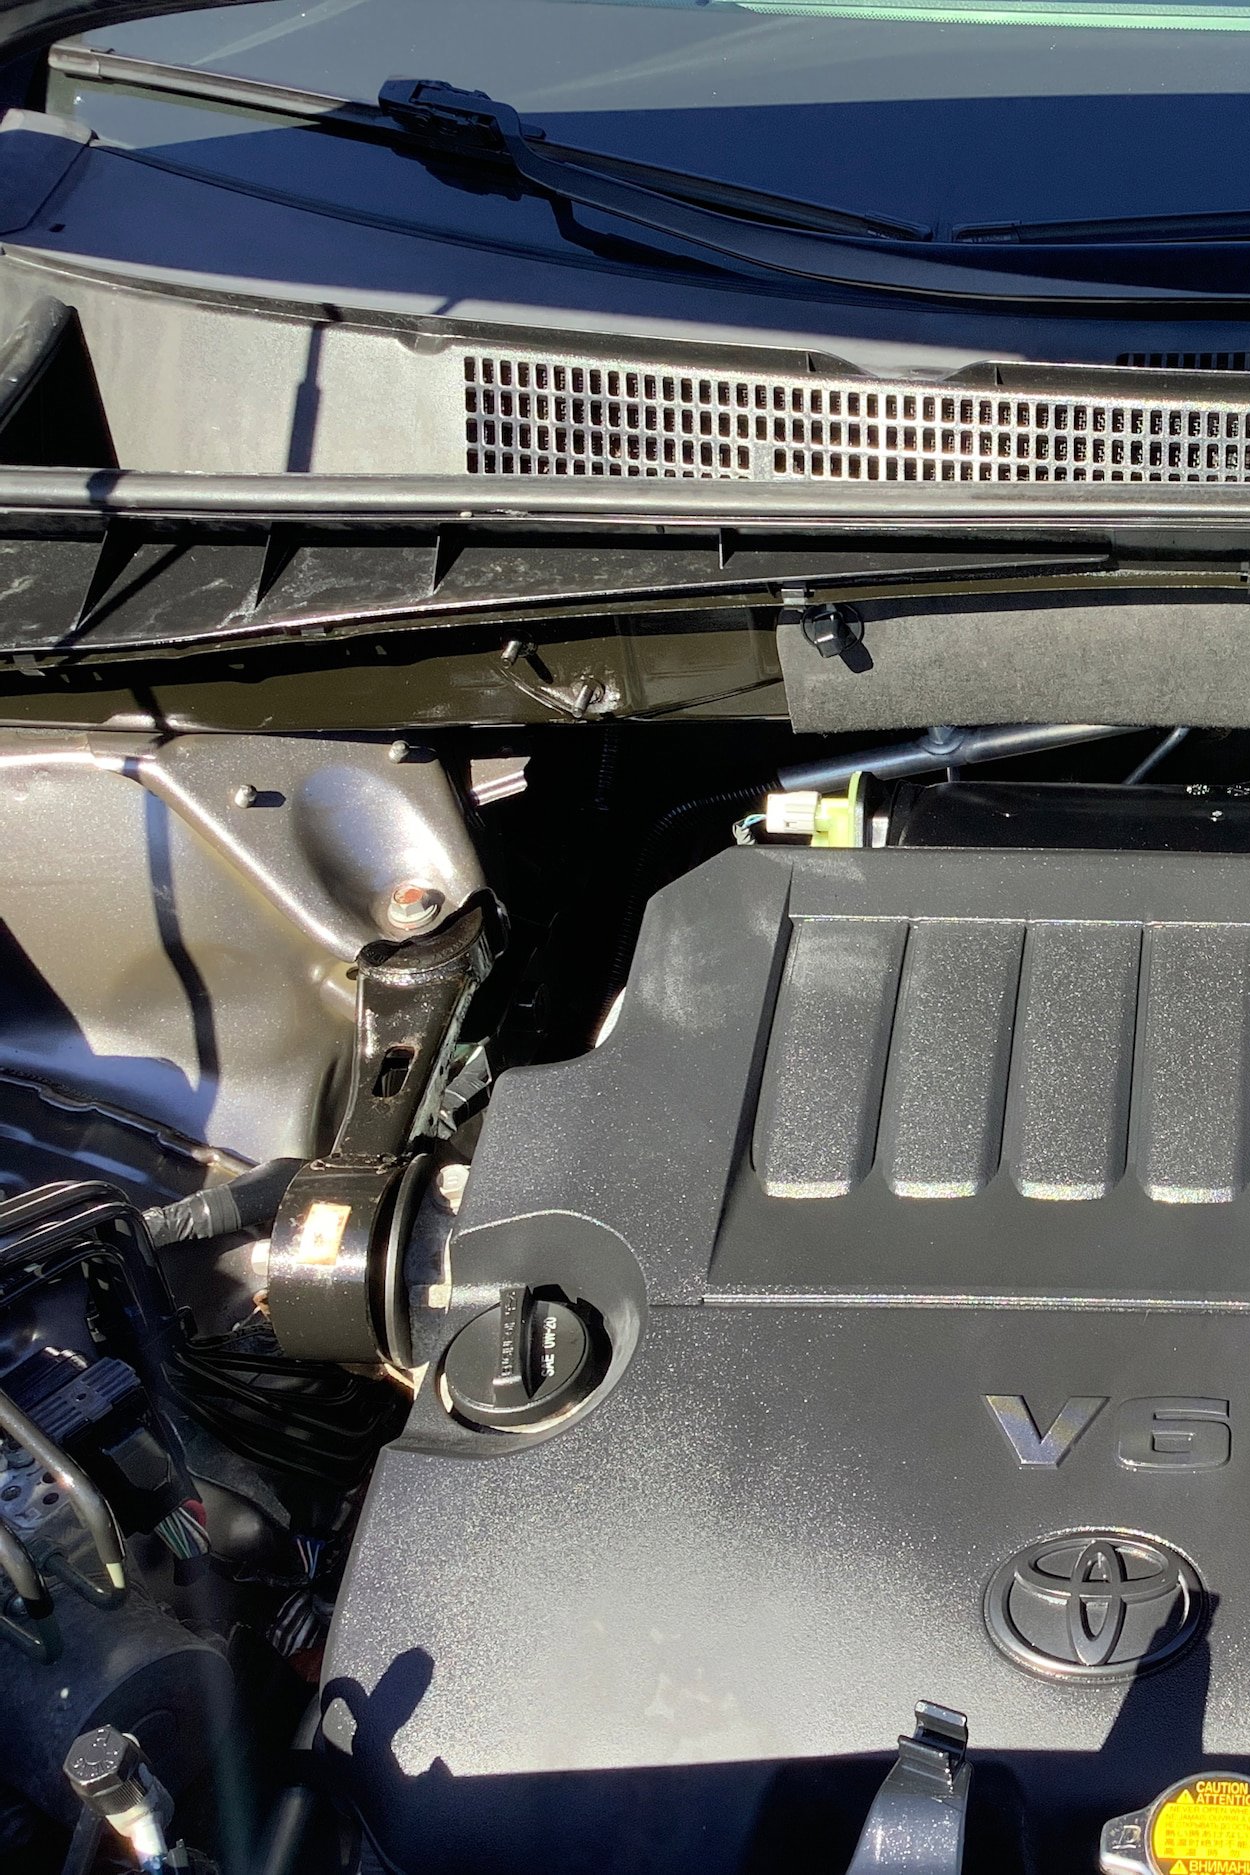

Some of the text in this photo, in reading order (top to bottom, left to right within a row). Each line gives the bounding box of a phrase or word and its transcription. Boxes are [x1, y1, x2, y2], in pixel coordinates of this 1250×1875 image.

[541, 1316, 558, 1378] SAE 0W-20
[977, 1393, 1233, 1473] V6
[1196, 1781, 1249, 1795] CAUTION
[1169, 1805, 1200, 1814] NEVER
[1202, 1806, 1228, 1815] OPEN
